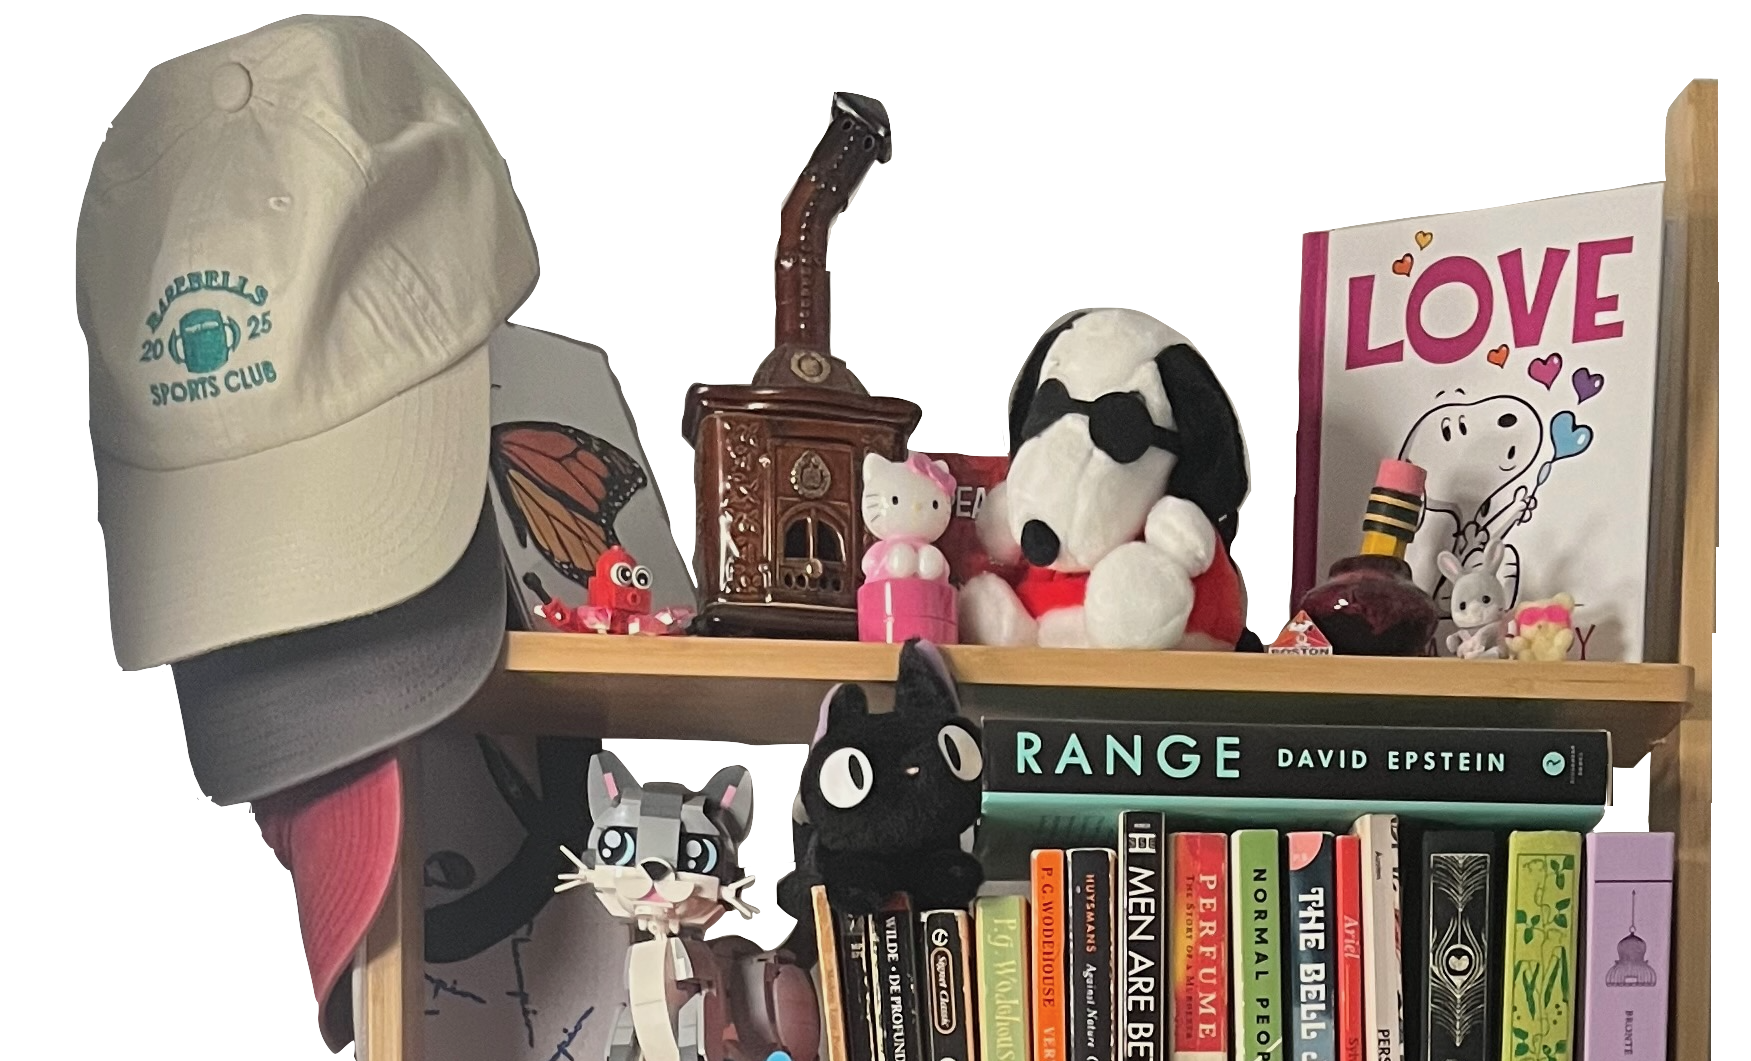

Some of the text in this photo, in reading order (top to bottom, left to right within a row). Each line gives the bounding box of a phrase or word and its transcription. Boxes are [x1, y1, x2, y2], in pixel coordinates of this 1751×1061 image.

[1345, 236, 1634, 371] LOVE
[140, 310, 273, 362] 20 25
[150, 360, 278, 407] SPORTS CLUB
[1016, 731, 1506, 779] RANGE DAVID EPSTEIN
[1085, 874, 1097, 953] HUYSMANS
[1127, 865, 1156, 941] MEN
[1253, 868, 1269, 981] NORMAL
[1298, 886, 1326, 952] THE
[885, 916, 899, 963] WILDE
[1041, 899, 1056, 1008] WODEHOUSE
[1197, 873, 1218, 1039] PERFUME
[1344, 914, 1361, 960] Ariel
[888, 974, 902, 994] DE
[1082, 963, 1098, 1006] Against
[1127, 950, 1156, 1012] ARE
[1299, 962, 1327, 1040] BELL
[1086, 1007, 1099, 1048] Nature
